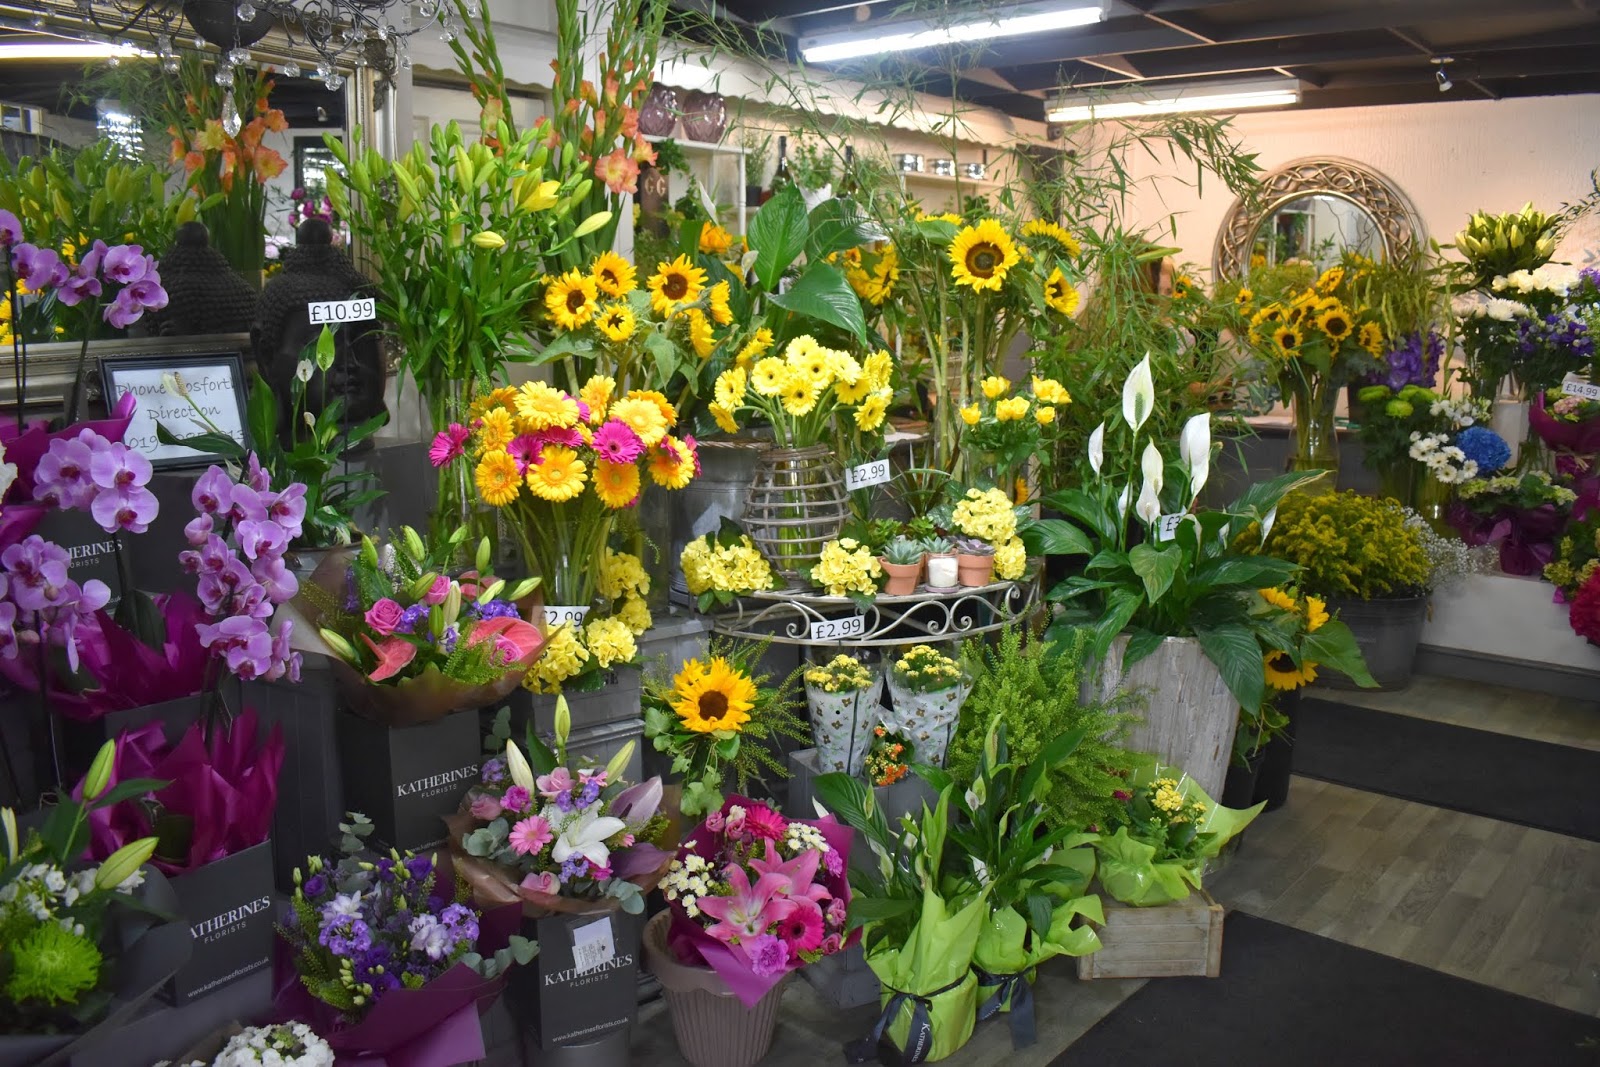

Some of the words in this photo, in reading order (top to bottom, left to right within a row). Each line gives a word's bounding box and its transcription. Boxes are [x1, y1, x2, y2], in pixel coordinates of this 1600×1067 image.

[311, 301, 373, 322] £10.99
[115, 383, 167, 397] Phone
[186, 377, 233, 396] osfort
[1565, 383, 1598, 397] £14.99
[147, 405, 221, 420] Directon
[851, 464, 885, 484] £2.99
[70, 557, 100, 569] ORISTS
[816, 618, 861, 639] £2.99
[397, 764, 478, 797] KATHERINES
[421, 783, 457, 798] FLORISTS
[190, 895, 271, 939] ATHERINES
[204, 921, 247, 944] FLORISTS
[569, 973, 609, 988] FLORISTS
